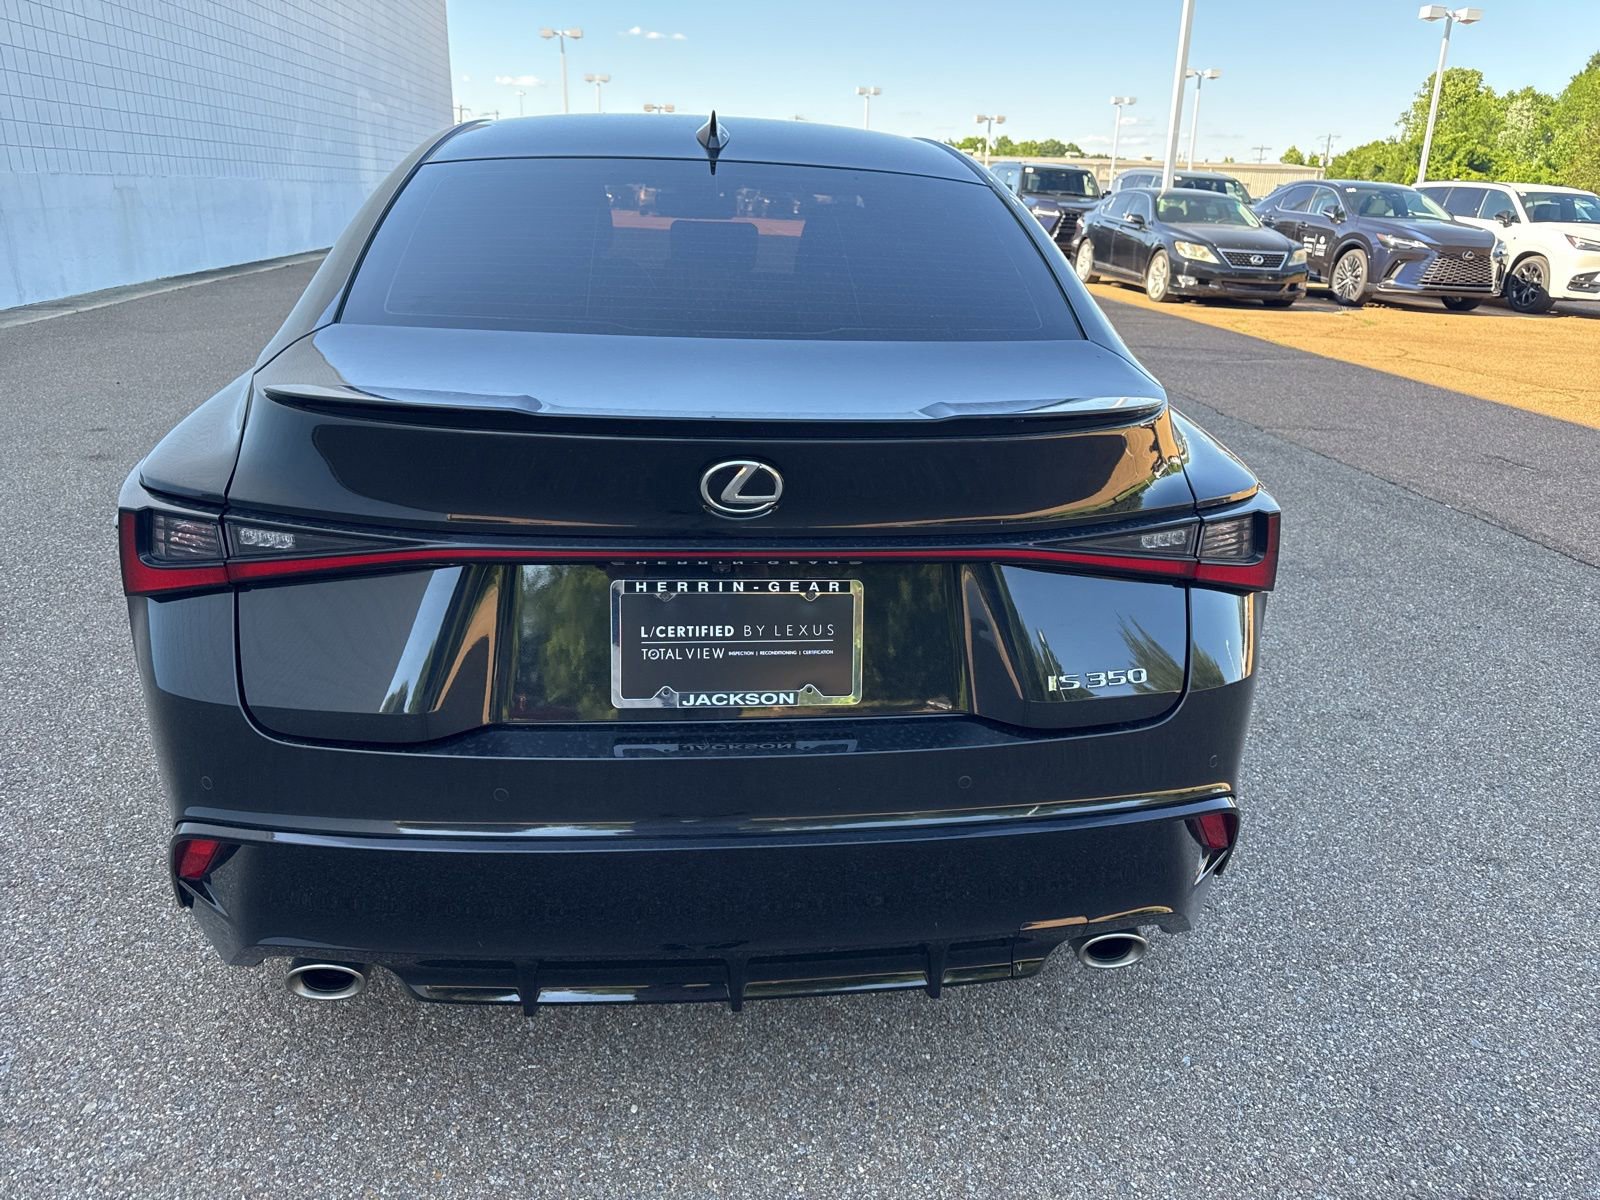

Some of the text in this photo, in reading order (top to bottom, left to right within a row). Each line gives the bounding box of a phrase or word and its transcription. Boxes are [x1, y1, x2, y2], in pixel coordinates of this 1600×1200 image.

[635, 581, 840, 593] HERRIN-GEAR
[640, 623, 835, 638] L/CERTIFIED BY LEXUS
[641, 648, 685, 660] TOTAL
[686, 647, 725, 660] VIEW
[1047, 668, 1148, 692] IS 350
[682, 692, 795, 706] JACKSON
